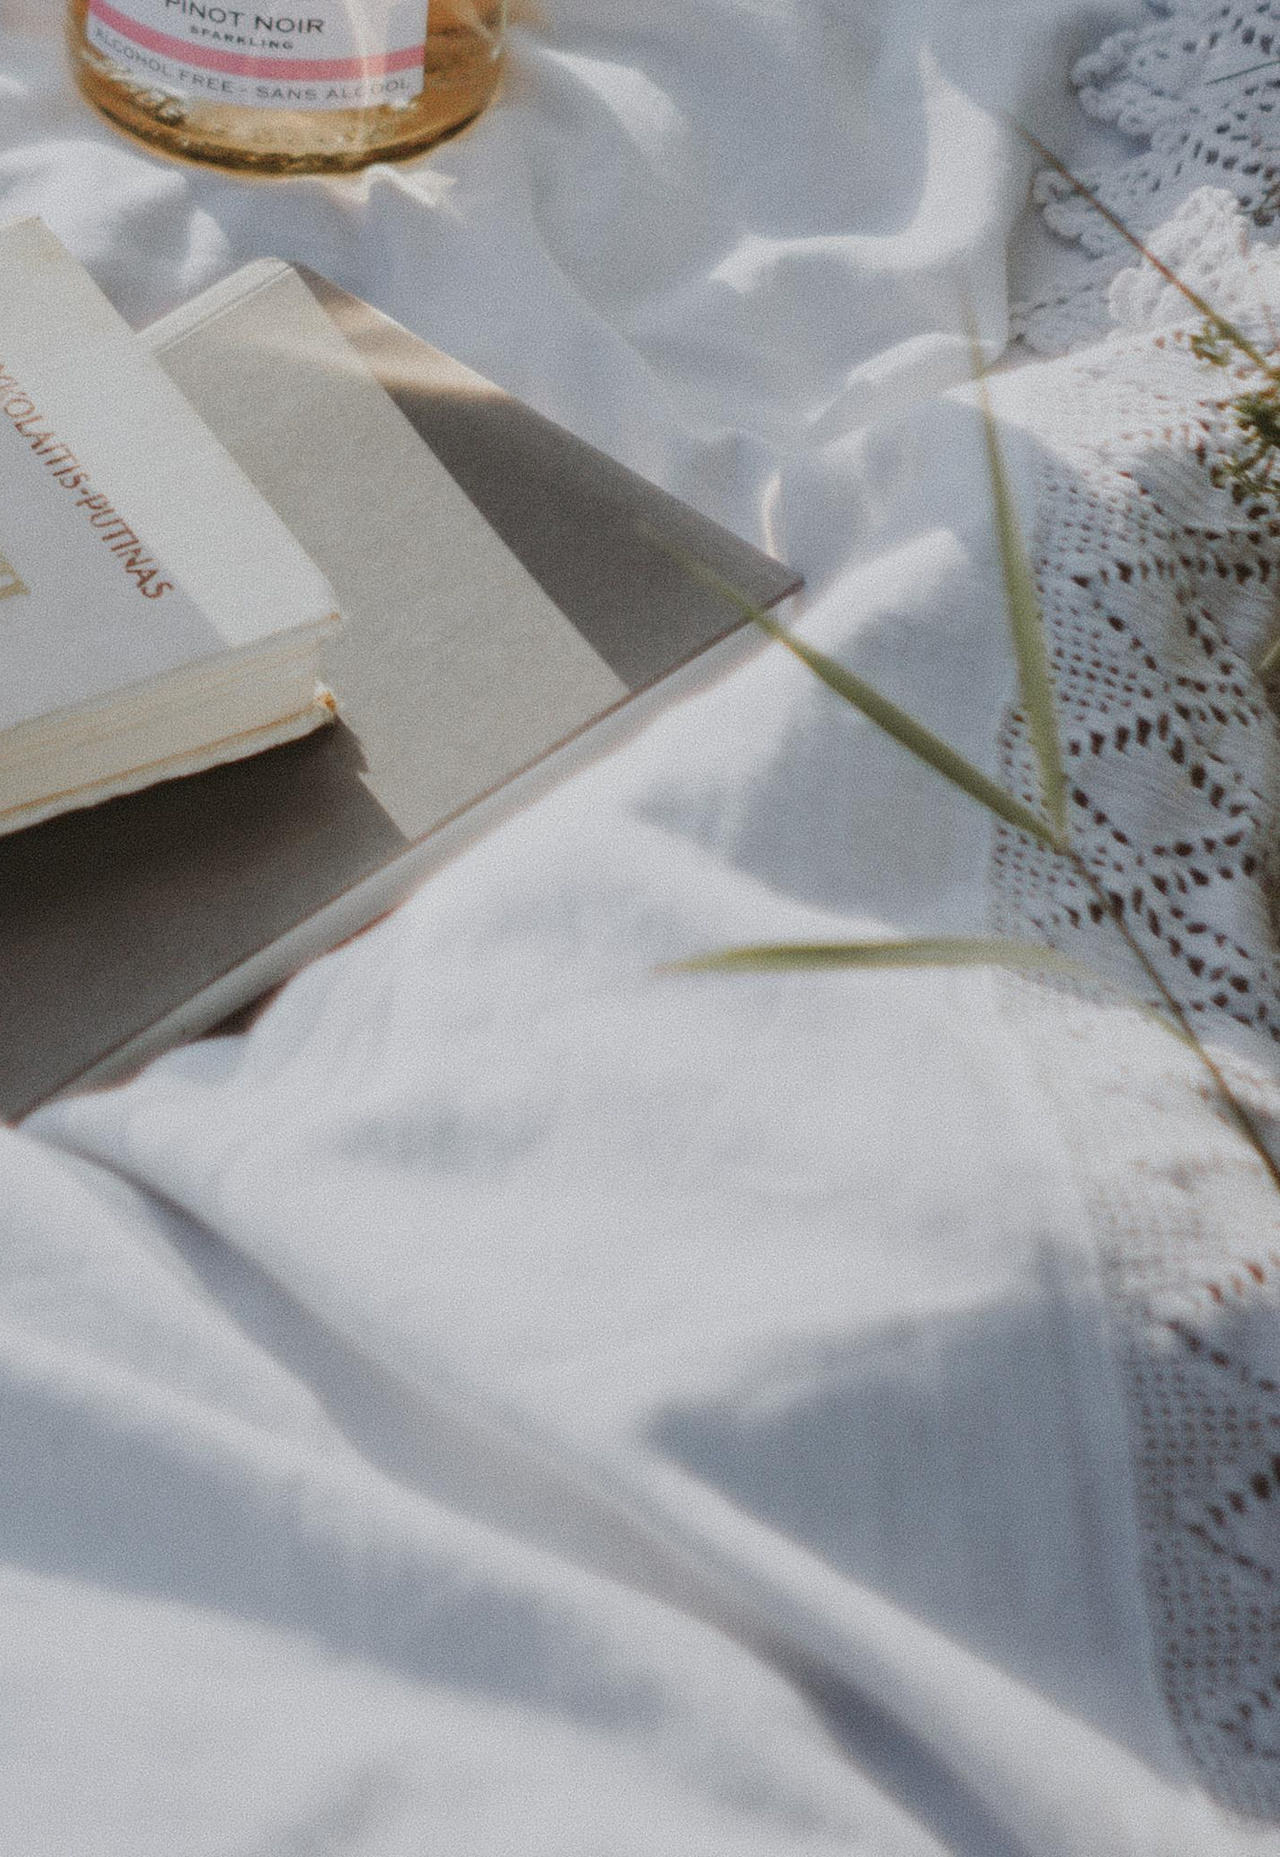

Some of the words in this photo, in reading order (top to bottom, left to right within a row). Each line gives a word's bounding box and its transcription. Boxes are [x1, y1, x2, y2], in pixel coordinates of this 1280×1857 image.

[189, 25, 294, 50] SPARKLING
[254, 15, 325, 35] NOIR
[94, 27, 171, 78] ALCOHOL
[178, 68, 234, 95] FREE
[255, 85, 318, 101] SANS
